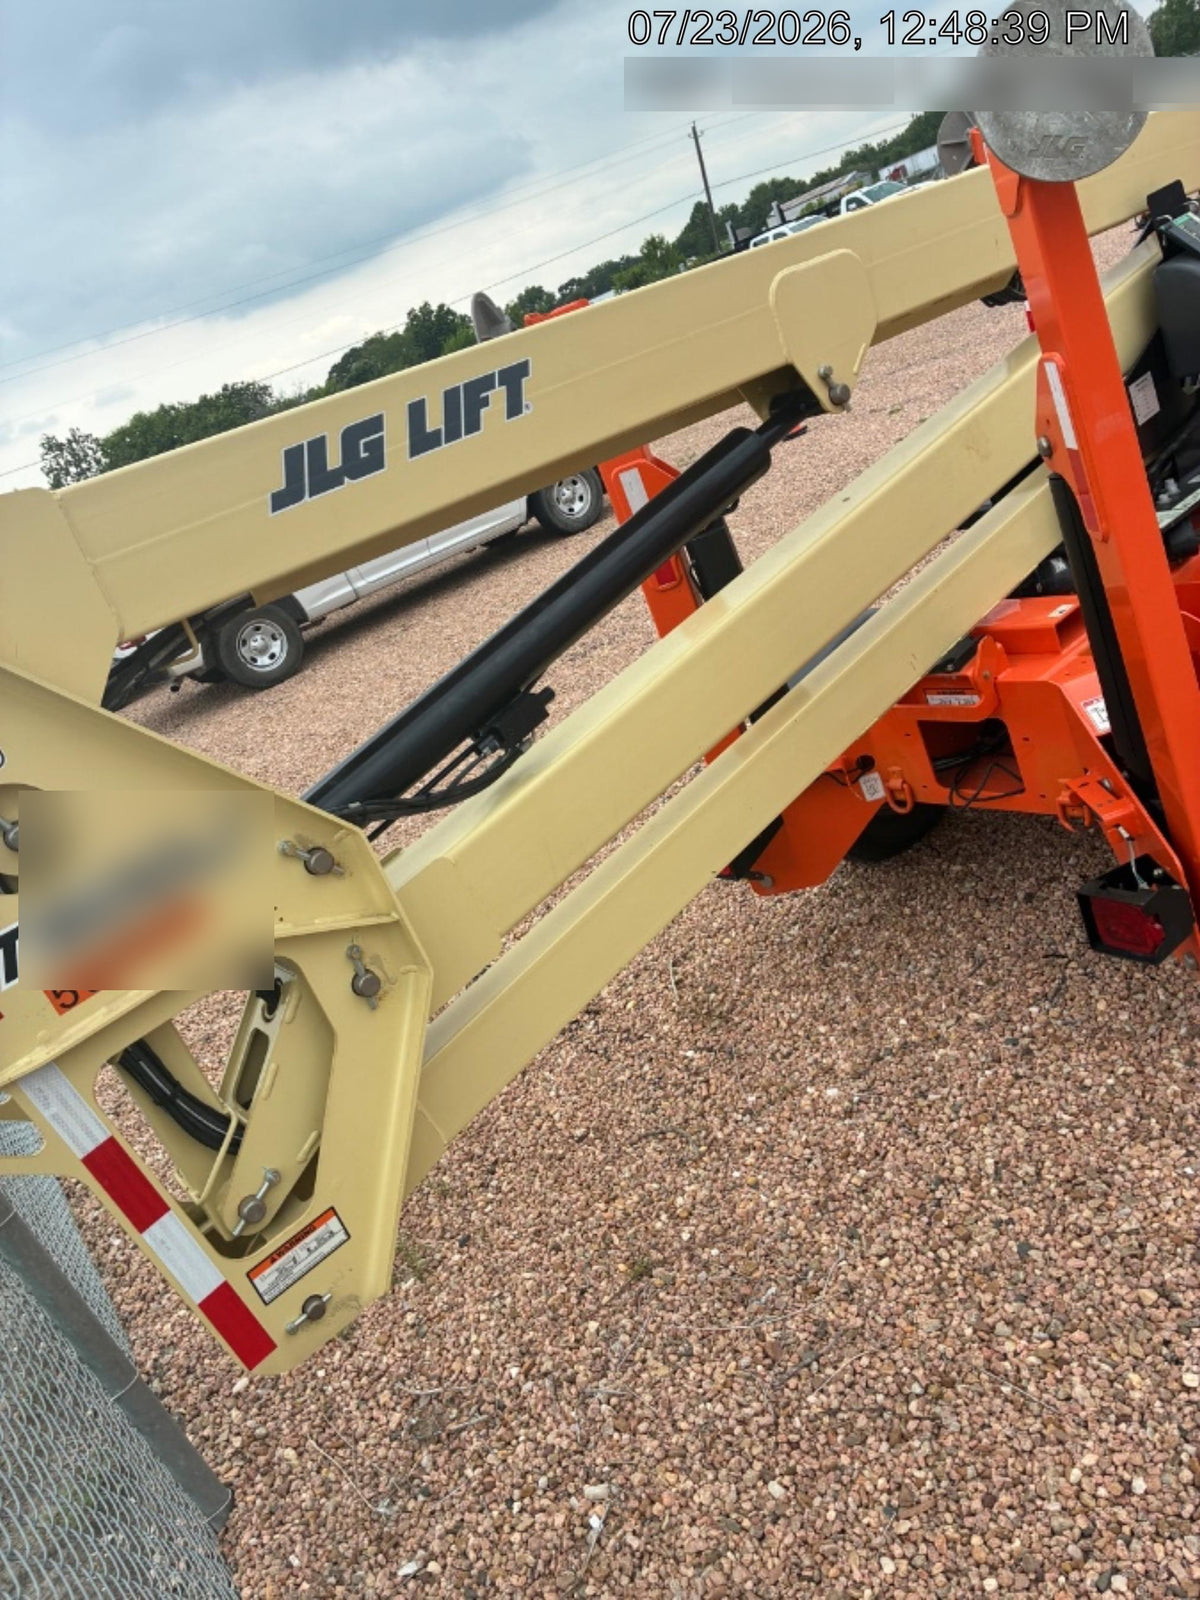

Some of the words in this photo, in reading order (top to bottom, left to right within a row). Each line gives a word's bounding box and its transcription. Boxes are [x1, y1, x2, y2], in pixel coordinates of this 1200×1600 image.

[1027, 134, 1088, 159] JLG
[269, 411, 386, 515] JLG
[407, 358, 531, 461] LIFT
